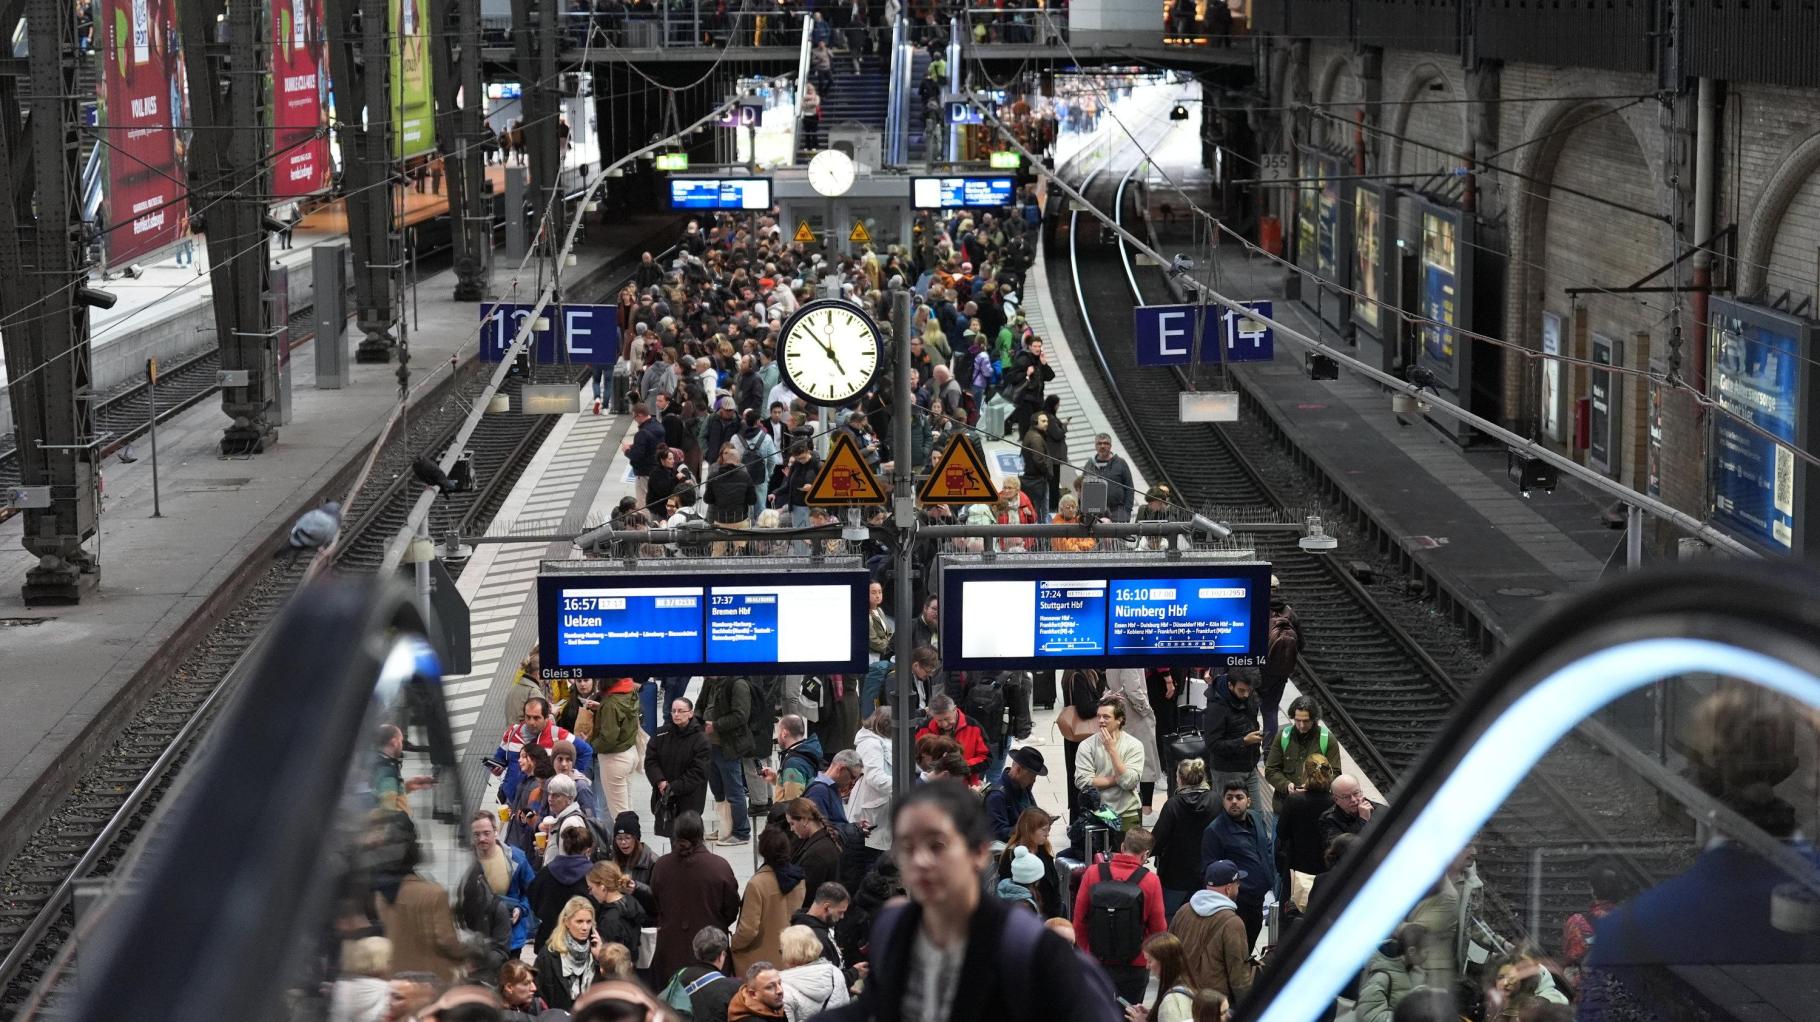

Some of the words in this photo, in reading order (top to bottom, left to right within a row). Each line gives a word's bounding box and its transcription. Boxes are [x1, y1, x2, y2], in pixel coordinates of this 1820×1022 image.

[742, 106, 756, 124] D
[952, 103, 966, 121] D
[1264, 156, 1287, 168] 355
[566, 311, 593, 354] E
[1158, 311, 1187, 356] E
[1040, 590, 1061, 598] 17:24
[1116, 588, 1148, 601] 16:10
[564, 598, 597, 611] 16:57
[712, 597, 733, 605] 17:37
[1040, 602, 1070, 610] Stuttgart
[1071, 601, 1083, 609] Hbf
[739, 607, 751, 615] Hbf
[1115, 604, 1165, 619] Nürnberg
[1168, 604, 1188, 617] Hbf
[564, 614, 602, 627] Uelzen
[1227, 656, 1253, 666] Gleis
[1256, 656, 1266, 665] 14
[542, 667, 569, 679] Gleis
[572, 667, 582, 678] 13
